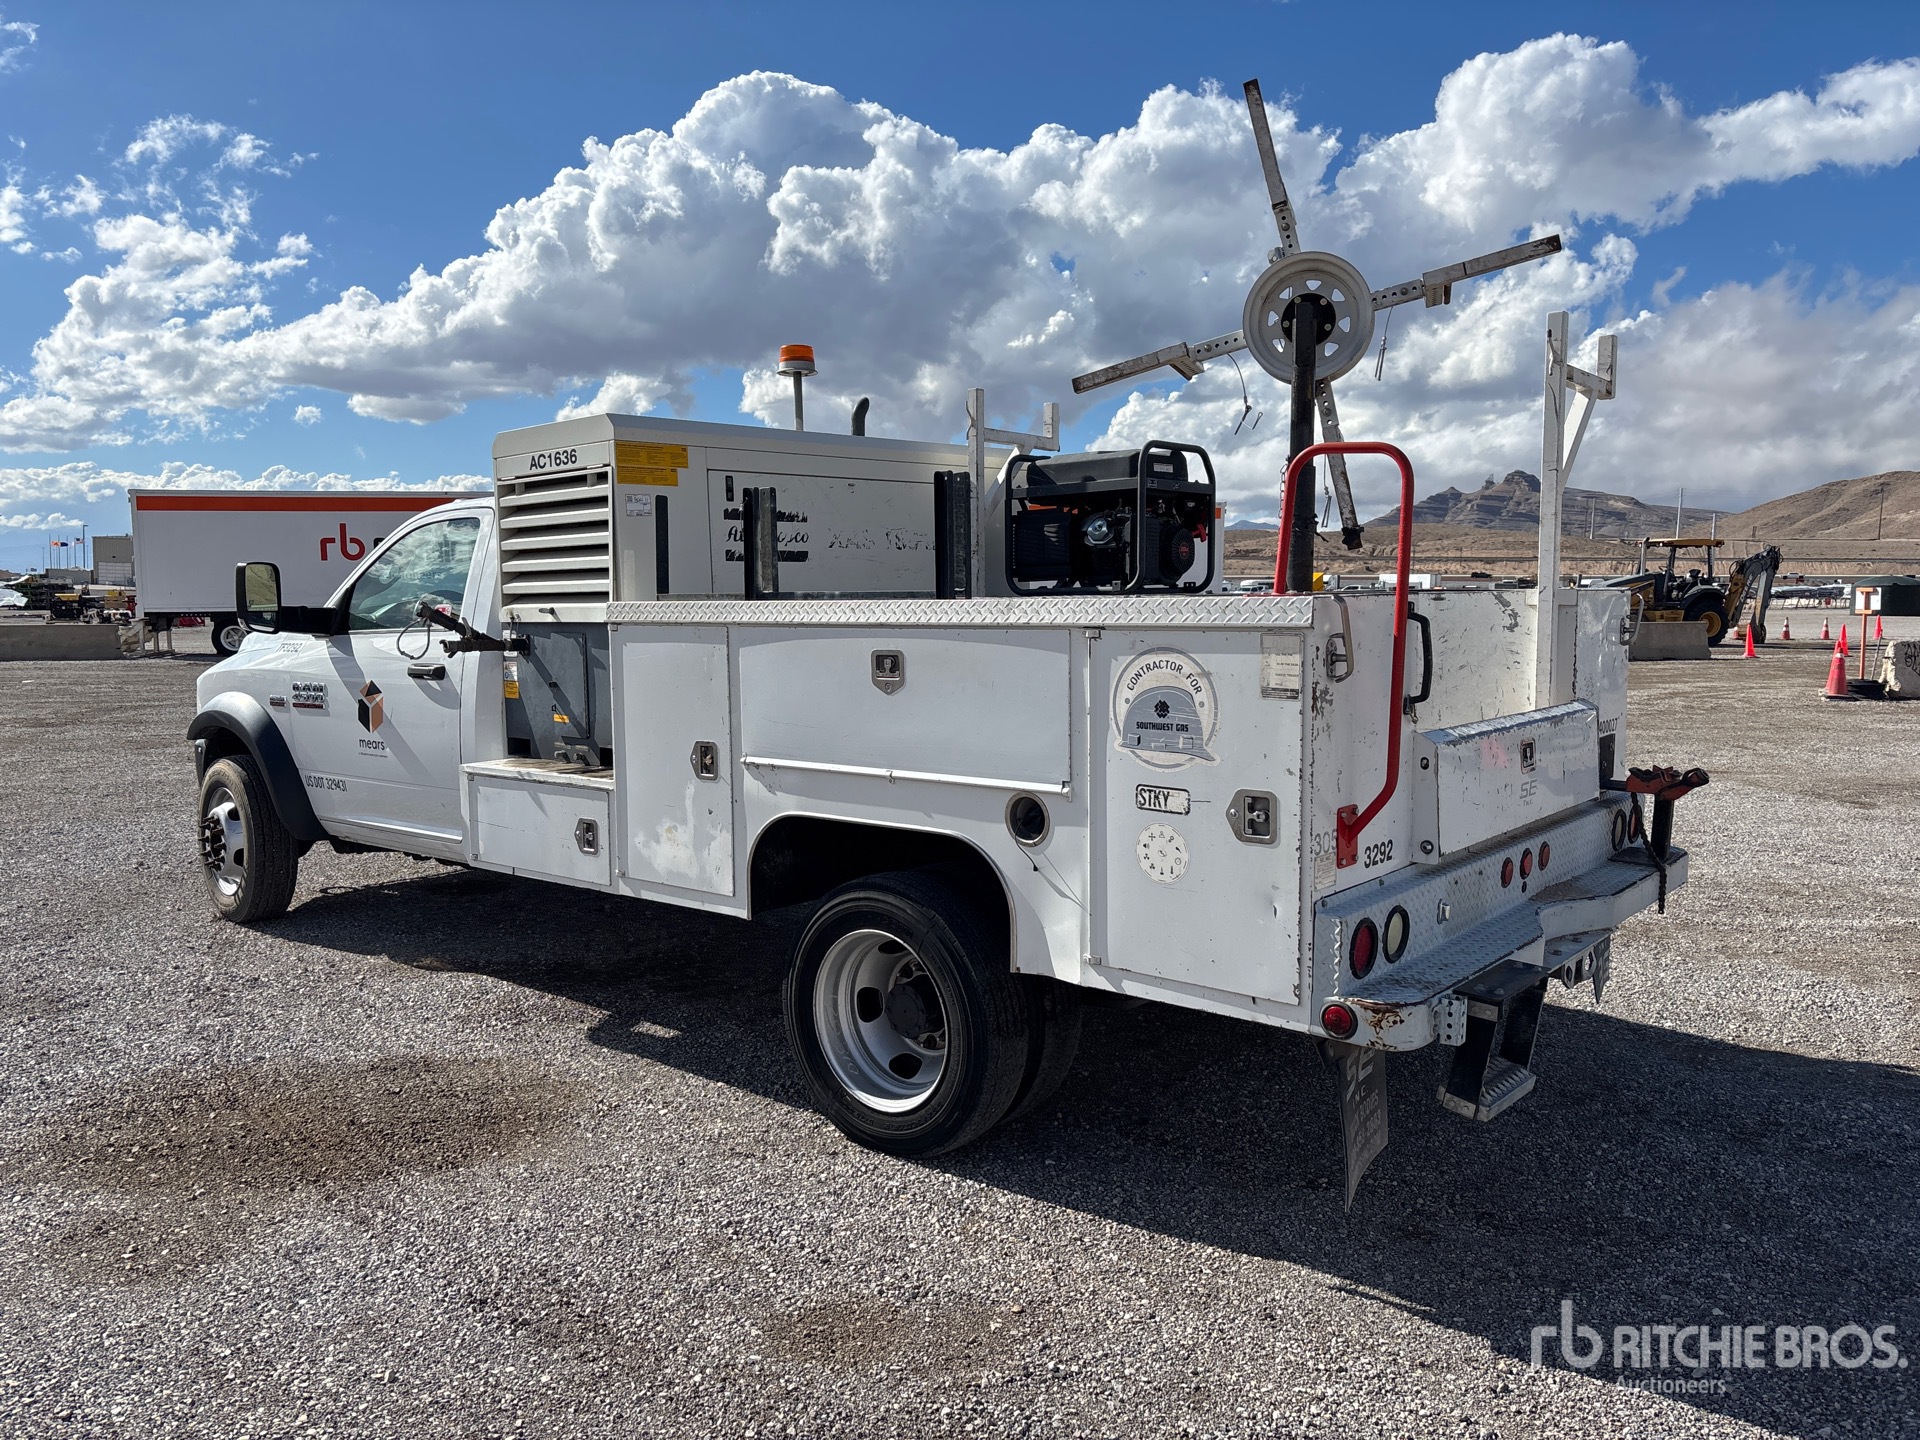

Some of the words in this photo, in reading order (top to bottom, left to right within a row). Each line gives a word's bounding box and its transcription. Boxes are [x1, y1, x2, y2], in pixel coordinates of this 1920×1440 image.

[529, 448, 577, 470] AC1636
[319, 522, 366, 561] rb
[292, 681, 324, 692] RAM
[1126, 659, 1184, 691] CONTRACTOR
[1185, 672, 1203, 694] FOR
[1136, 721, 1173, 731] SOUTHWEST
[1175, 723, 1189, 732] GAS
[359, 738, 386, 751] mears
[304, 774, 314, 788] US
[314, 776, 325, 789] DOT
[1519, 778, 1539, 800] SE
[1139, 787, 1170, 809] STKY
[1363, 838, 1393, 869] 3292
